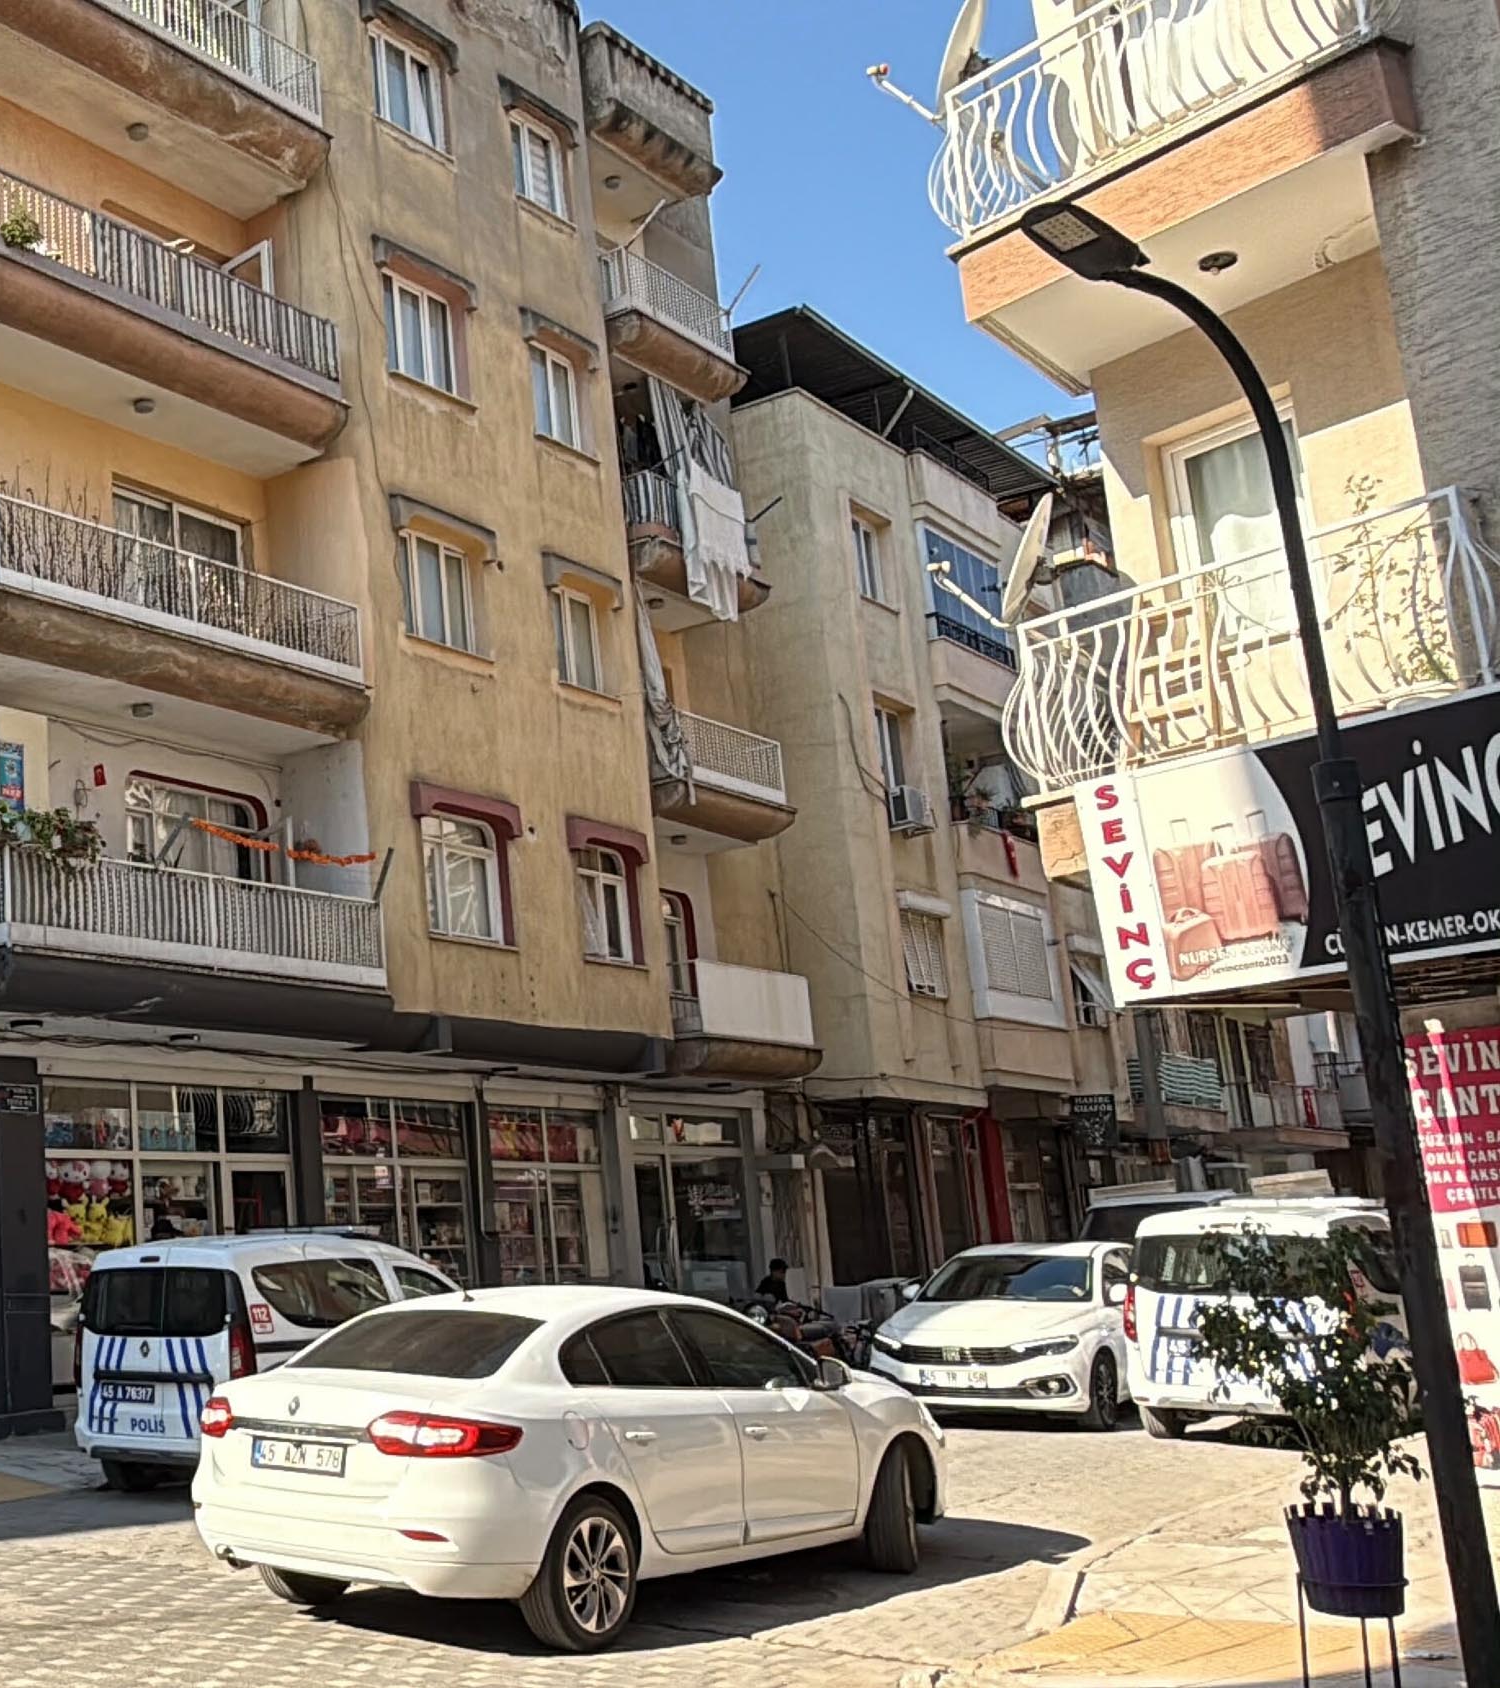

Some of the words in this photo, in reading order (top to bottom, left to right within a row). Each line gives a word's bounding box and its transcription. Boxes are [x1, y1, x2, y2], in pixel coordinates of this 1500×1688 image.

[1362, 739, 1500, 878] EVİN
[1094, 784, 1156, 990] SEVİNÇ
[1426, 1150, 1466, 1166] OKUL
[1470, 1167, 1500, 1181] AKS
[251, 1306, 270, 1322] 112
[101, 1384, 115, 1399] 45
[116, 1385, 123, 1399] A
[125, 1386, 153, 1401] 76317
[130, 1415, 166, 1434] POLİS
[261, 1443, 276, 1462] 45
[316, 1448, 341, 1468] 578
